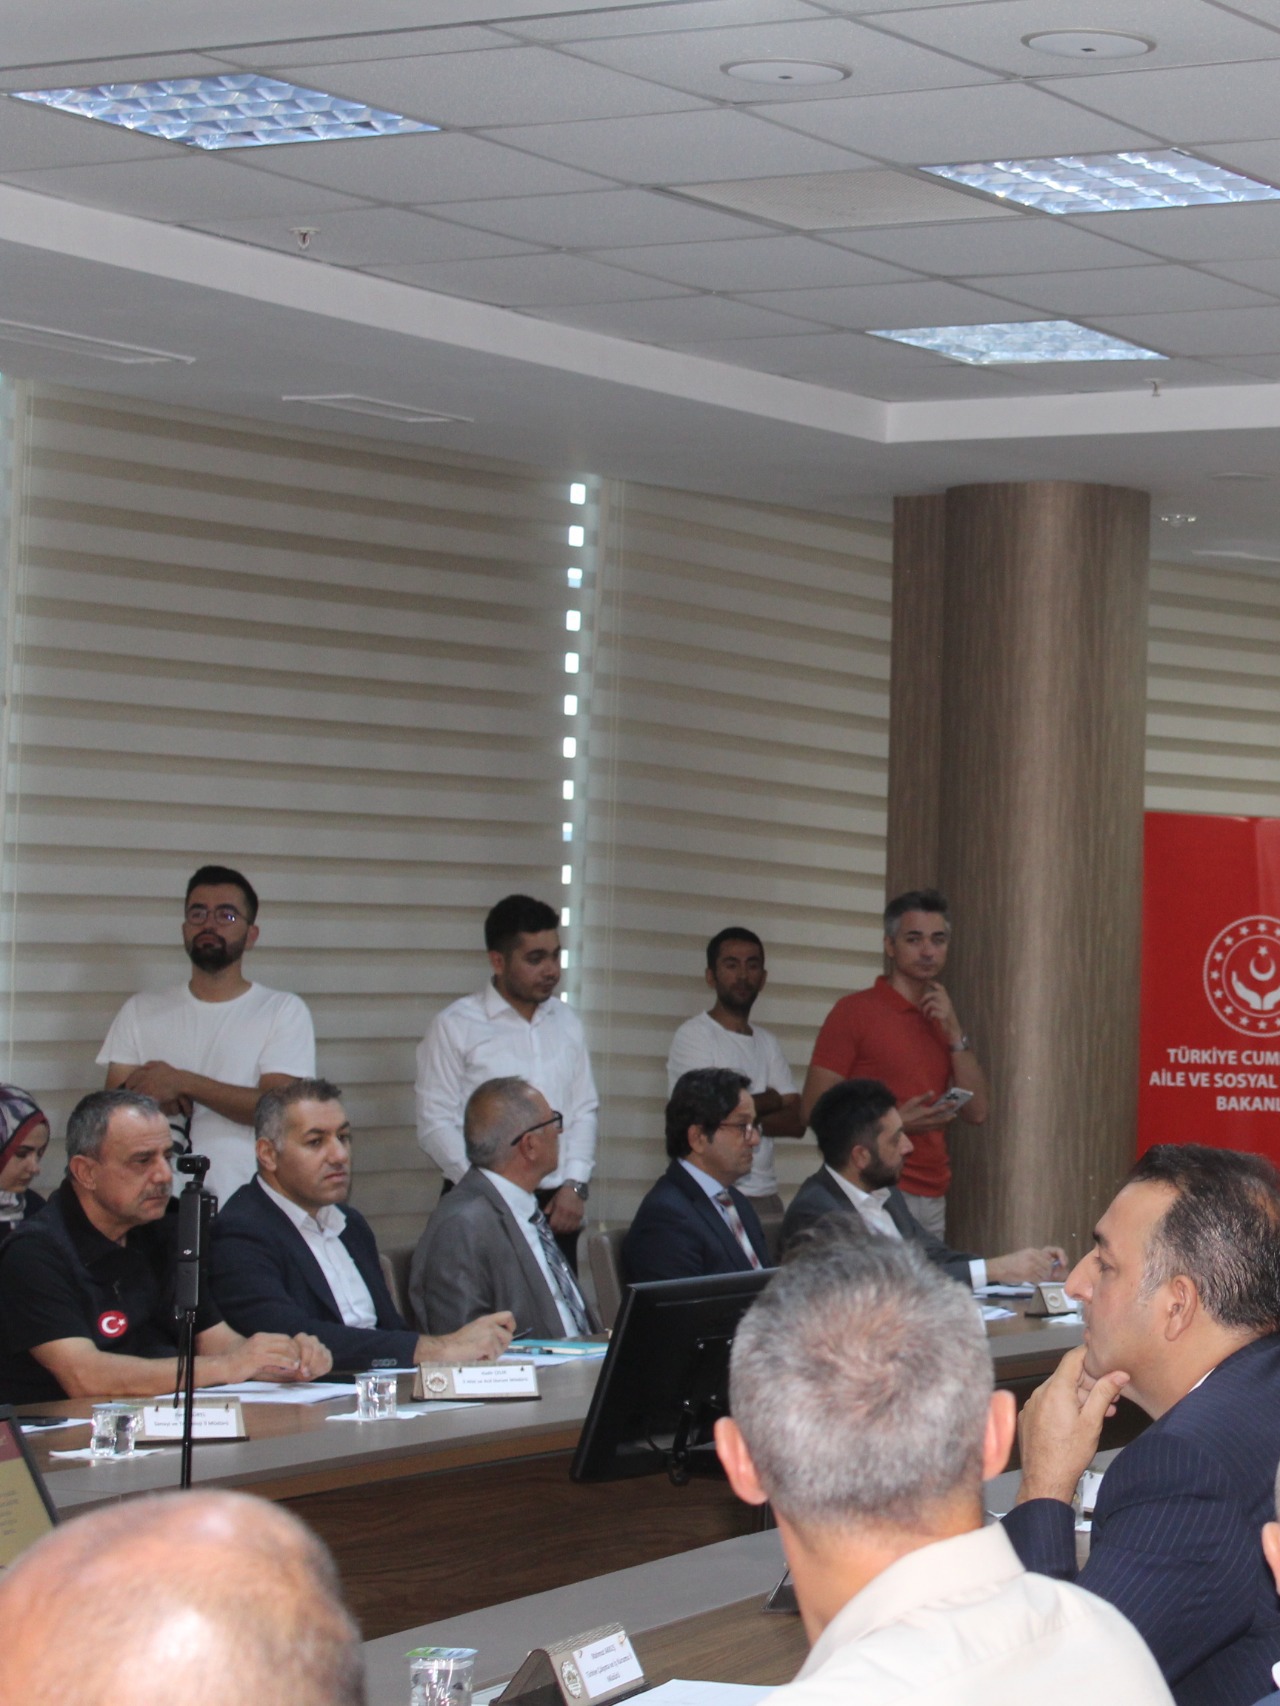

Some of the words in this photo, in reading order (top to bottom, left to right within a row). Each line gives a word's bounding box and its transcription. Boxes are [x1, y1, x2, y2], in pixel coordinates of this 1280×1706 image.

[1167, 1046, 1238, 1066] TÜRKİYE
[1149, 1069, 1187, 1087] AİLE
[1189, 1072, 1211, 1088] VE
[1213, 1072, 1278, 1089] SOSYAL
